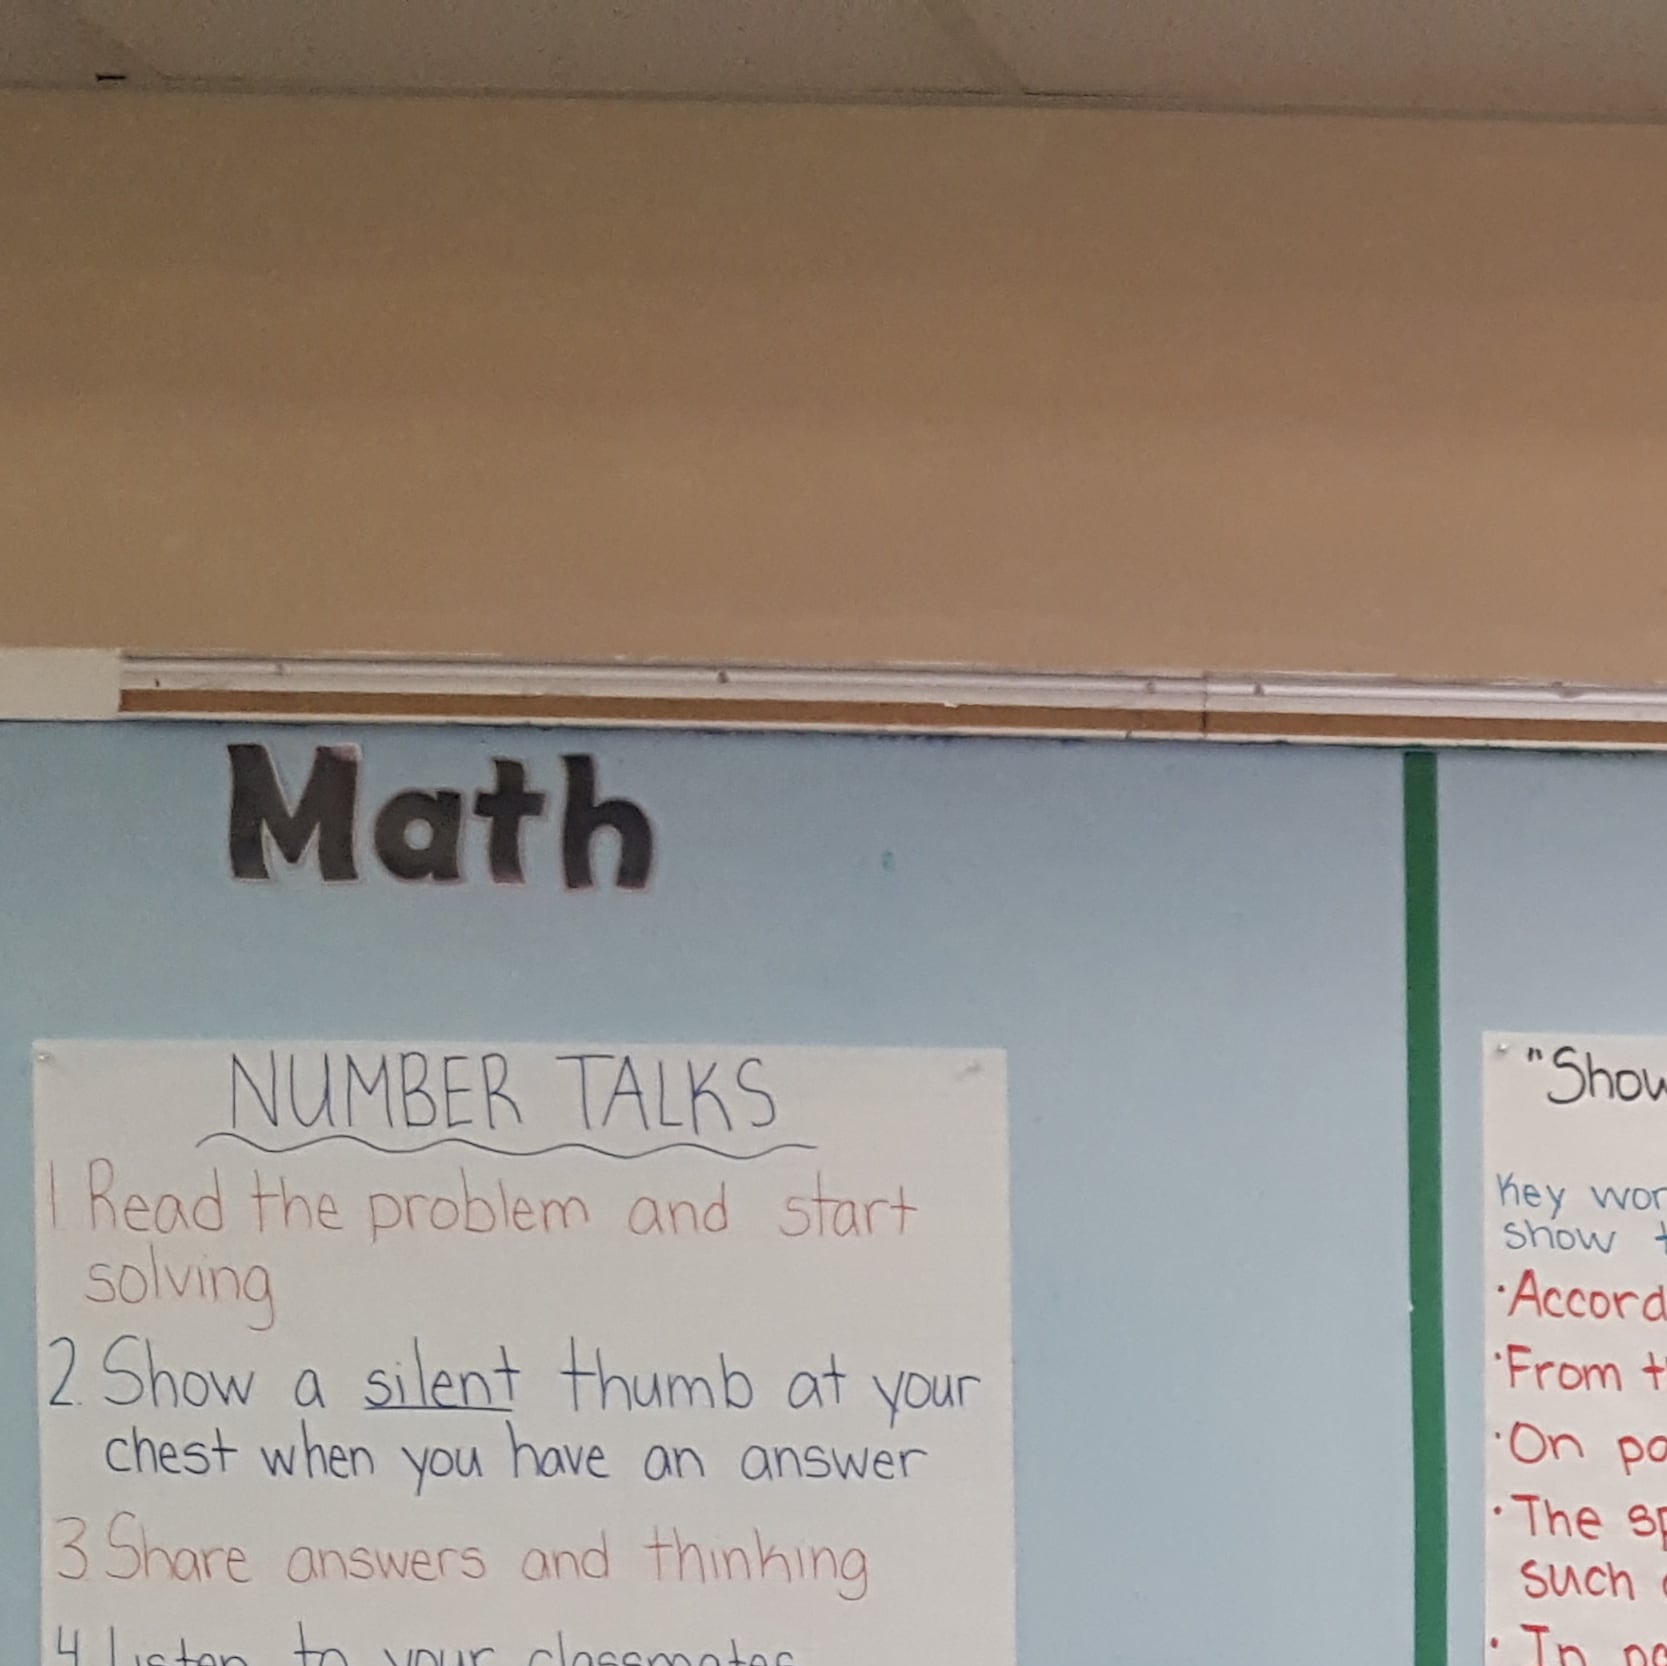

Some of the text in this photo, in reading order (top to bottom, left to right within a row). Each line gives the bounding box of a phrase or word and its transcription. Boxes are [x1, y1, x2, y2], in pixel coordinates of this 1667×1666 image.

[227, 741, 655, 892] Math
[231, 1049, 777, 1137] NUMBER TALKS
[88, 1157, 224, 1235] Read
[250, 1168, 344, 1233] the
[368, 1166, 590, 1244] problem
[627, 1180, 729, 1236] and
[779, 1171, 919, 1238] start
[1503, 1218, 1617, 1255] show
[84, 1243, 276, 1332] solving
[48, 1334, 982, 1430] 2. Show a silent thumb at your
[105, 1510, 251, 1584] Share
[286, 1545, 486, 1584] answers
[521, 1530, 610, 1582] and
[644, 1526, 868, 1602] thinking
